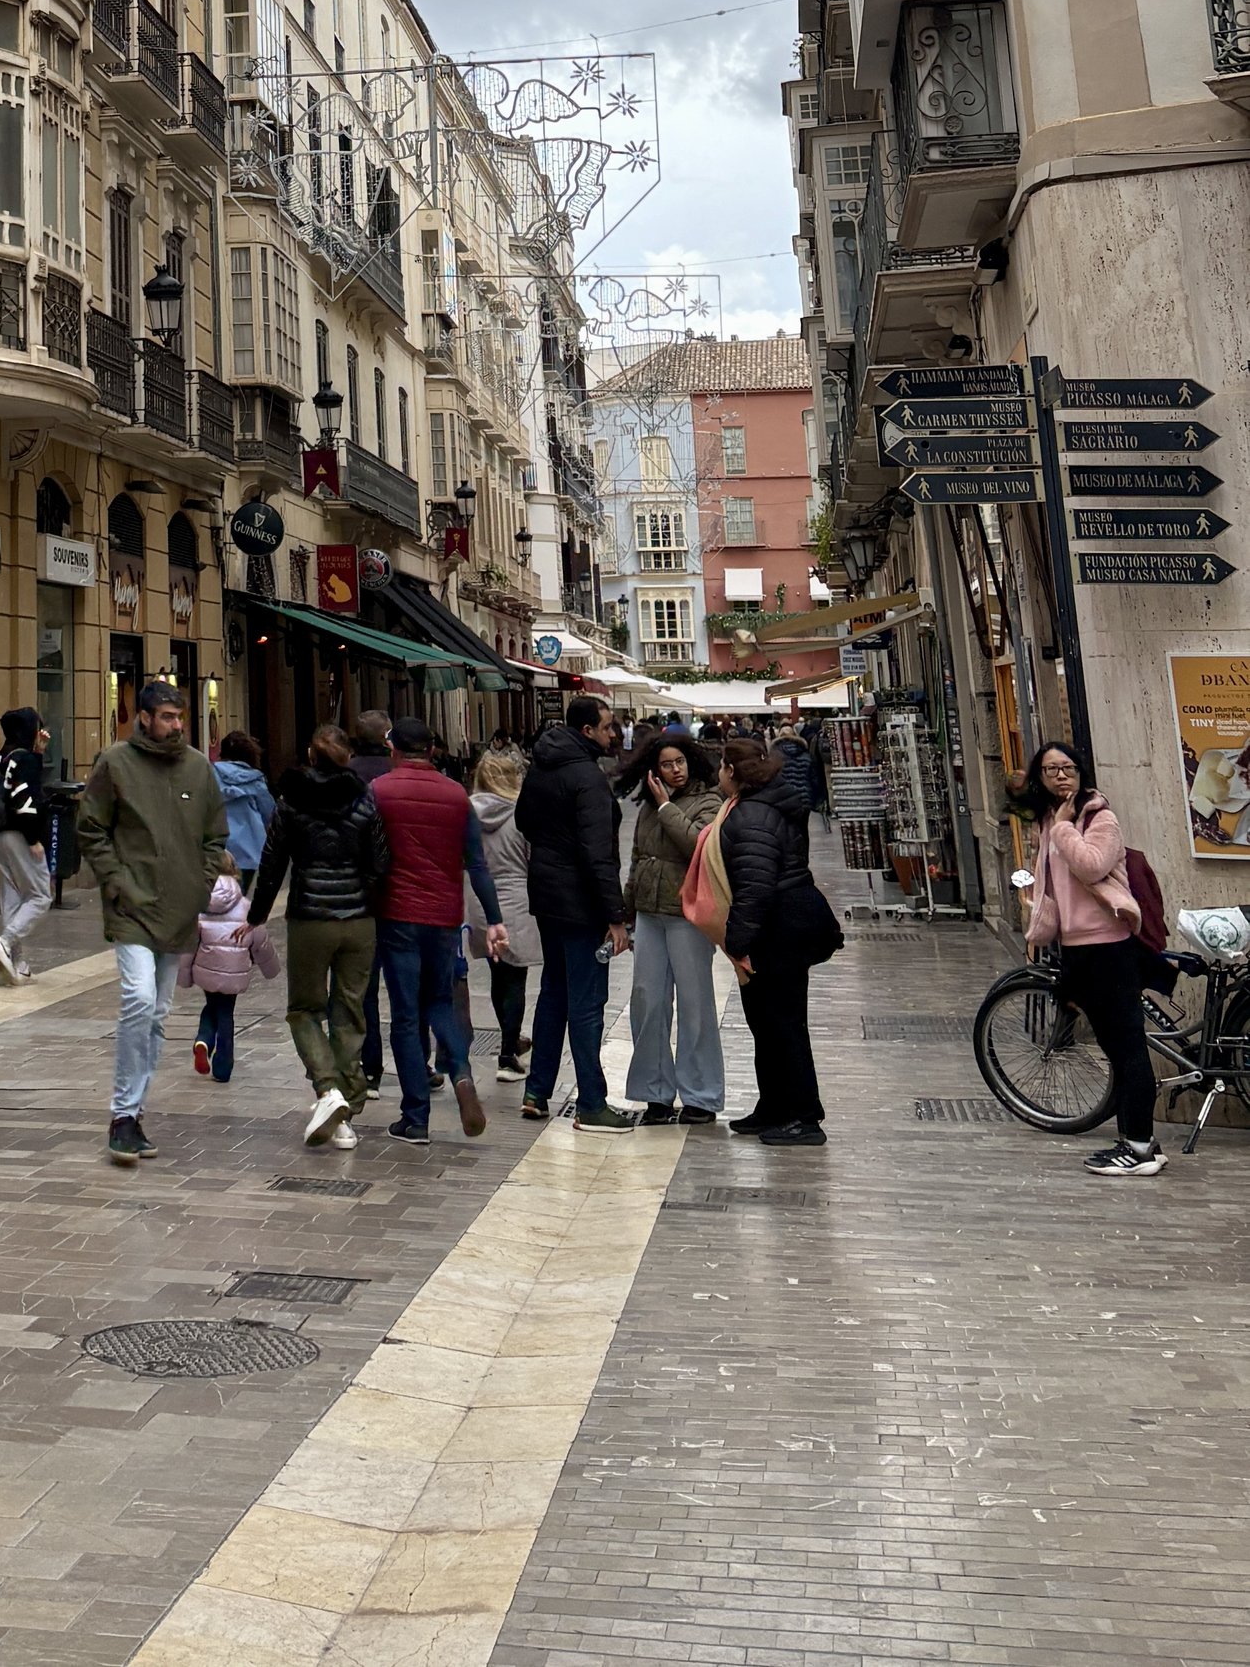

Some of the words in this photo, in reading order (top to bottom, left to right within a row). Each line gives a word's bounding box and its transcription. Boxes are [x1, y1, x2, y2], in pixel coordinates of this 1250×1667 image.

[911, 370, 964, 383] HAMMAM
[1066, 383, 1096, 391] MUSEO
[1067, 392, 1121, 406] PICASSO
[1126, 392, 1171, 406] MÁLAGA
[991, 402, 1022, 413] MUSEO
[918, 414, 966, 427] CARMEN
[969, 413, 1023, 426] THYSSEN
[1072, 425, 1106, 434] IGLESIA
[1108, 425, 1124, 434] DEL
[987, 439, 1013, 448] PLAZA
[1015, 438, 1026, 447] DE
[1072, 435, 1138, 449] SAGRARIO
[927, 451, 941, 464] LA
[944, 448, 1027, 463] CONSTITUCIÓN
[1073, 474, 1115, 488] MUSEO
[1117, 473, 1133, 488] DE
[1134, 470, 1184, 489] MÁLAGA
[946, 483, 979, 495] MUSEO
[983, 482, 1002, 494] DEL
[1004, 481, 1030, 493] VINO
[1079, 512, 1112, 522] MUSEO
[234, 520, 278, 545] GUINNESS
[1080, 523, 1135, 536] REVELLO
[1139, 524, 1154, 536] DE
[1157, 524, 1190, 536] TORO
[53, 547, 89, 568] SOUVENIRS
[1084, 554, 1147, 568] FUNDACIÓN
[1150, 556, 1196, 568] PICASSO
[1086, 569, 1126, 581] MUSEO
[1129, 569, 1157, 581] CASA
[1159, 569, 1194, 581] NATAL
[1182, 705, 1212, 714] CONO
[1190, 718, 1214, 727] TINY
